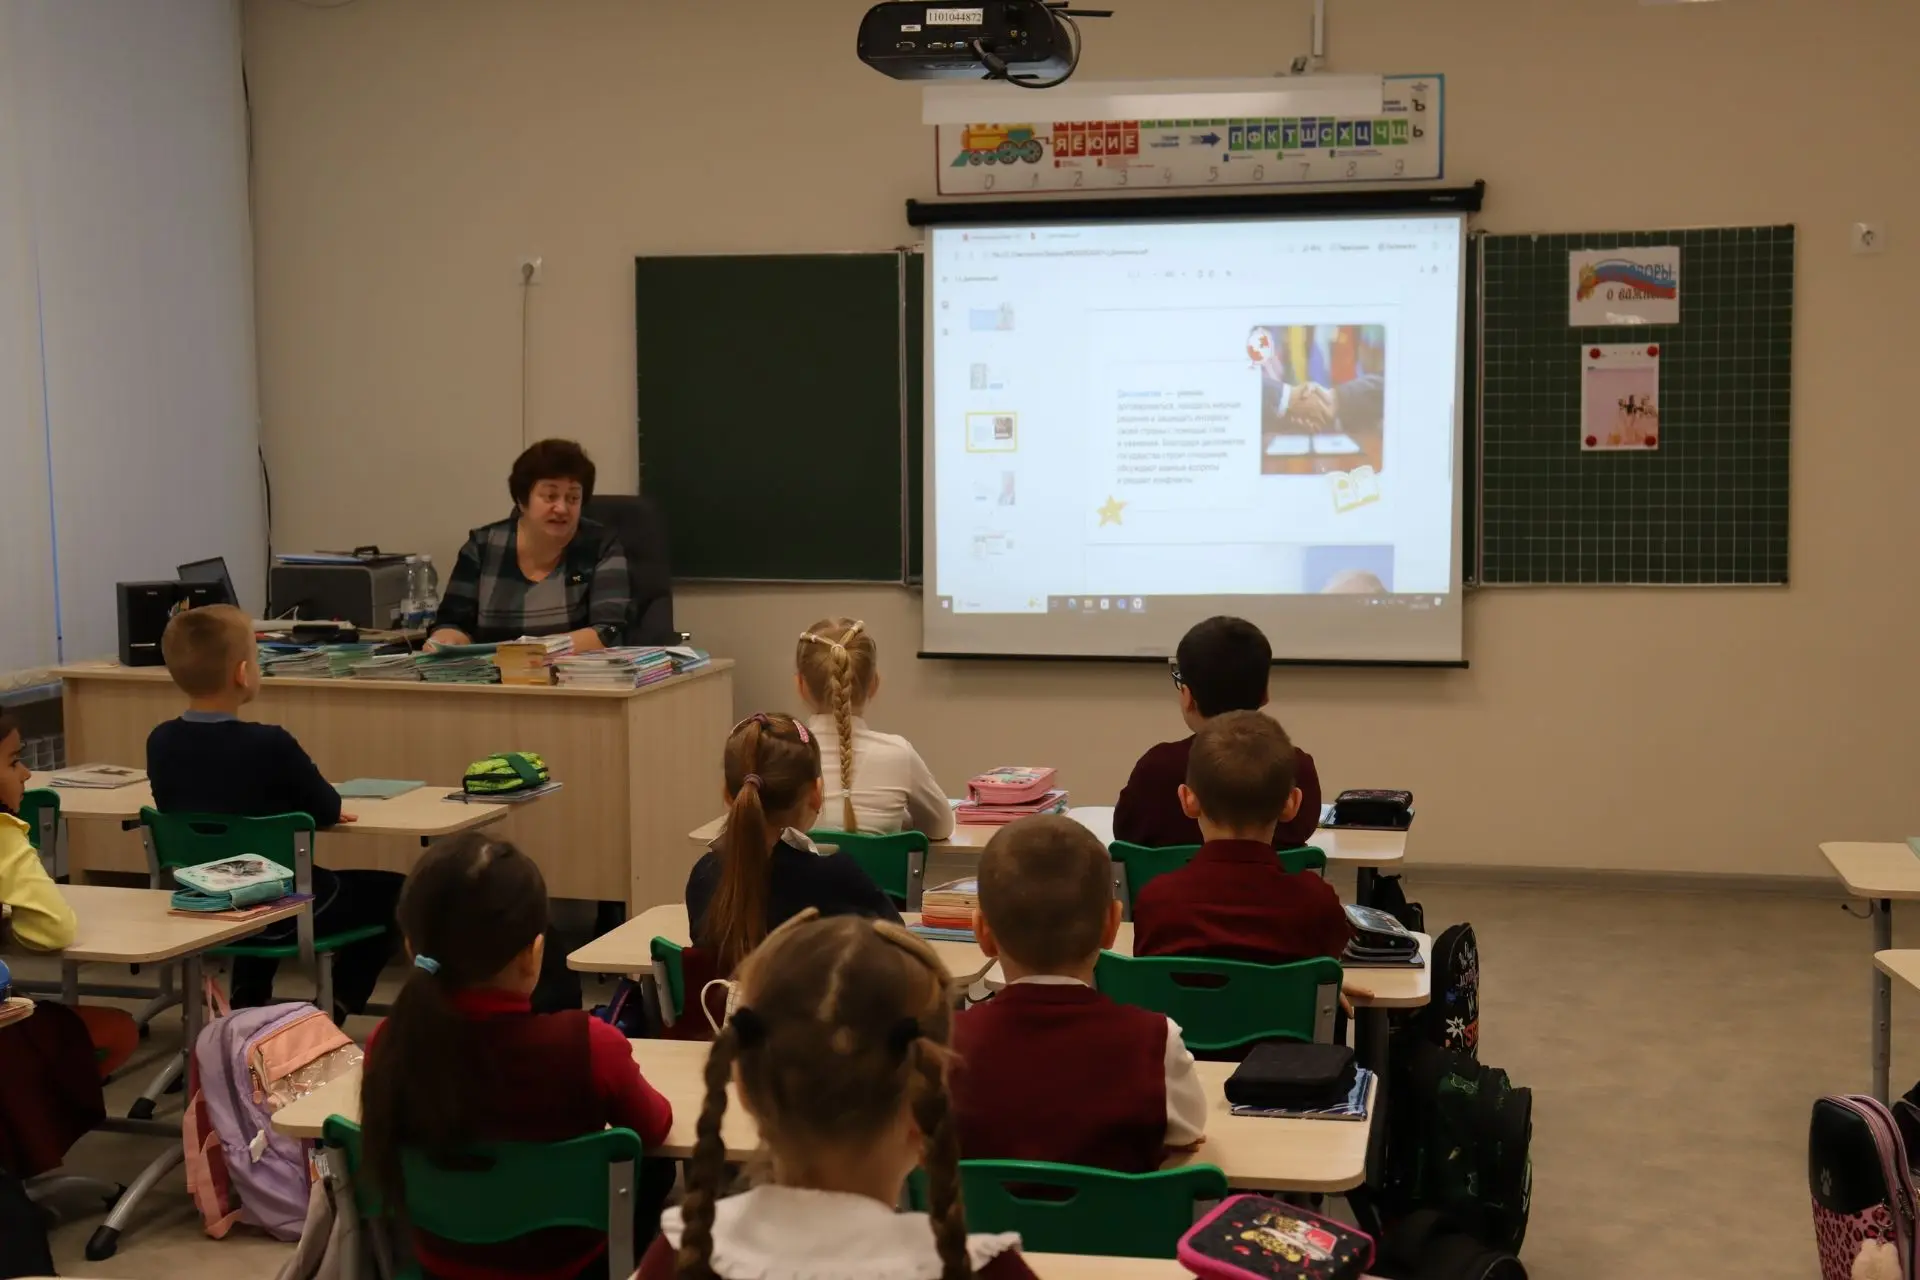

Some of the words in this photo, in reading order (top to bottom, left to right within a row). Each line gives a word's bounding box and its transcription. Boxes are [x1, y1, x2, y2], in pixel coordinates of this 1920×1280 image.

[928, 12, 982, 22] 1101044872
[1412, 98, 1426, 112] Ъ
[1248, 130, 1261, 143] Ф
[1267, 130, 1277, 143] К
[1286, 129, 1297, 143] Т
[1301, 127, 1316, 142] Ш
[1321, 127, 1332, 141] С
[1339, 127, 1350, 140] Х
[1356, 125, 1369, 141] Ц
[1375, 124, 1387, 139] Ч
[1391, 122, 1408, 141] Щ
[1412, 124, 1424, 138] Ь
[1056, 138, 1067, 151] Я
[1088, 136, 1102, 150] Ю
[1107, 135, 1118, 149] И
[1125, 135, 1137, 149] Е
[984, 174, 995, 190] 0
[1073, 171, 1083, 188] 2
[1118, 170, 1128, 186] 3
[1163, 168, 1172, 184] 4
[1207, 167, 1219, 183] 5
[1253, 165, 1264, 181] 6
[1300, 162, 1310, 179] 7
[1346, 161, 1357, 178] 8
[1394, 159, 1405, 176] 9
